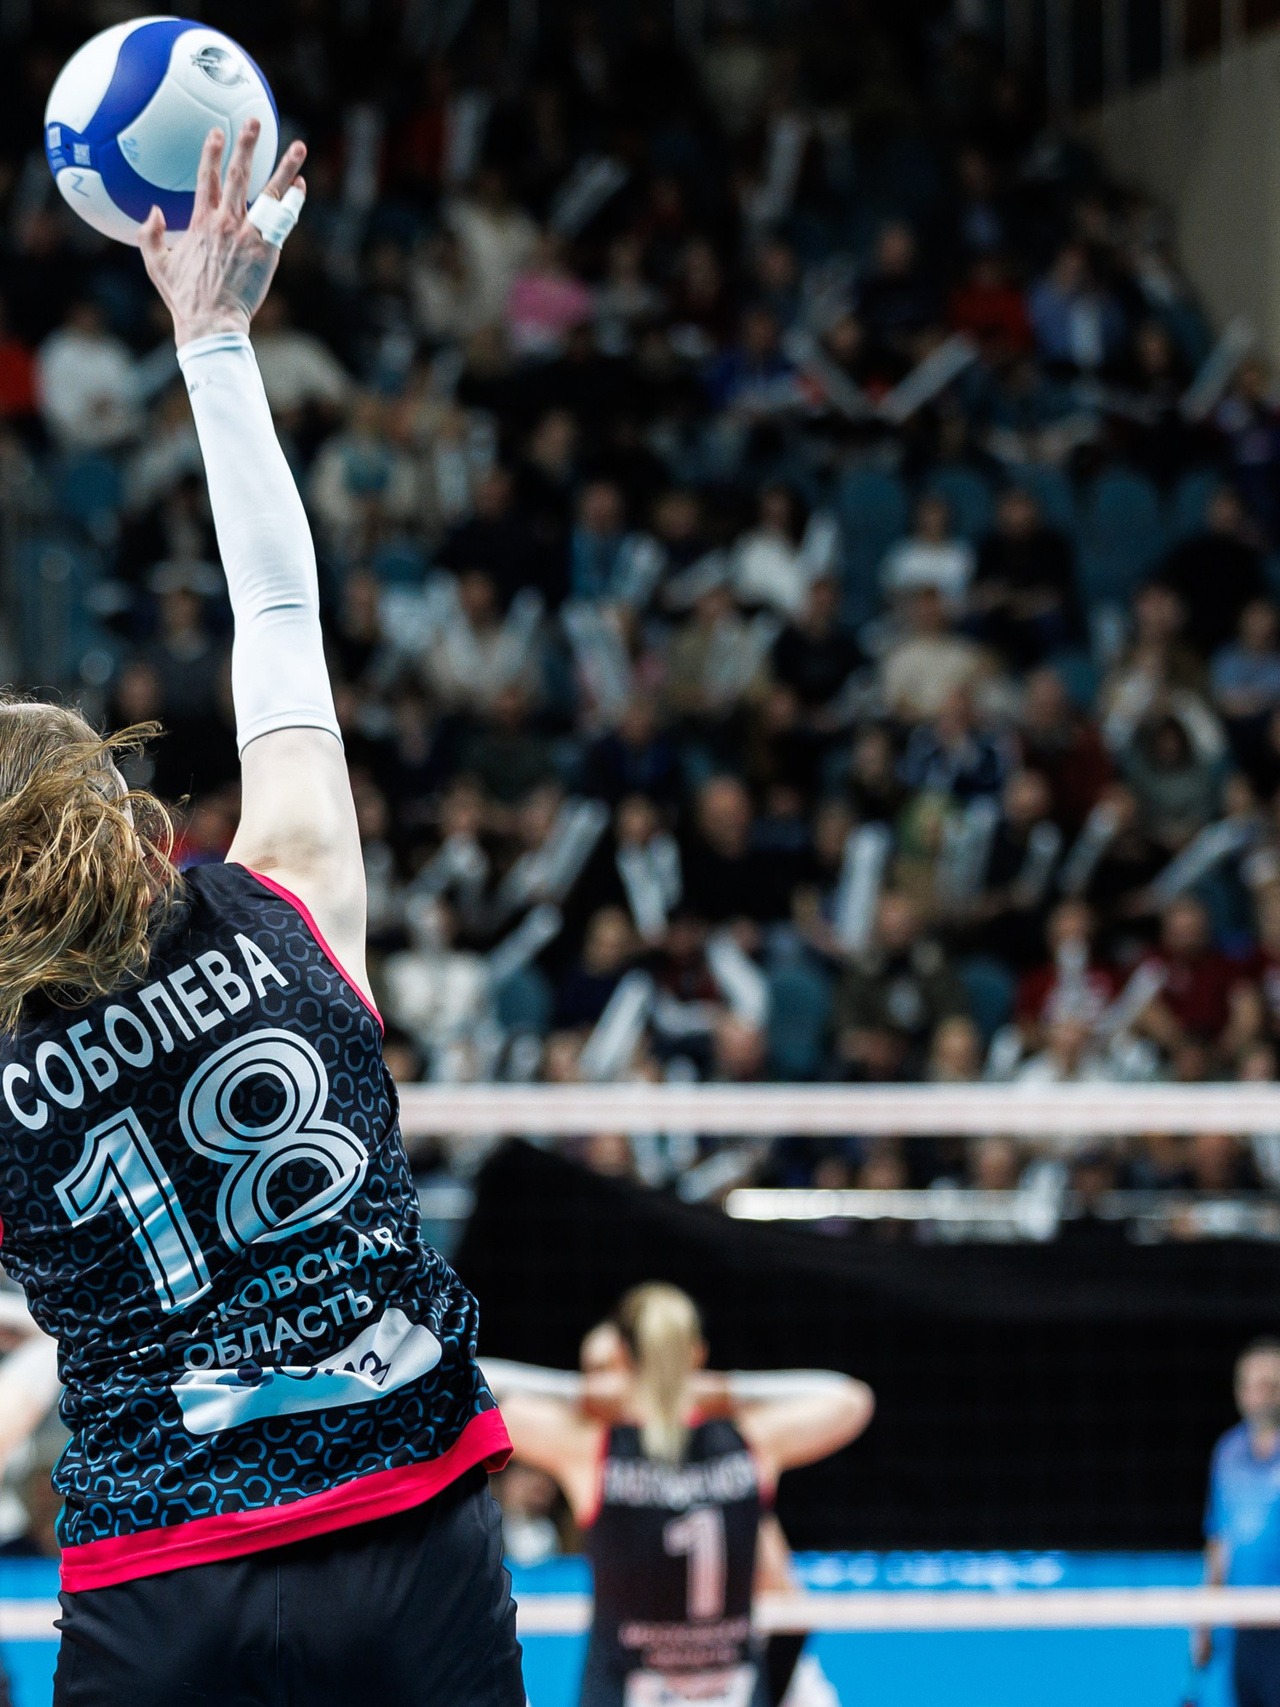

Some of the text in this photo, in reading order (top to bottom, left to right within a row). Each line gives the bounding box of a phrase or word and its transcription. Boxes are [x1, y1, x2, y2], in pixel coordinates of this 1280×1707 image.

[2, 933, 289, 1130] СОБОЛЕВА
[53, 1027, 369, 1313] 18
[167, 1226, 402, 1342] КОВСКАЯ
[183, 1289, 374, 1371] ОБЛАСТЬ
[663, 1506, 727, 1618] 1
